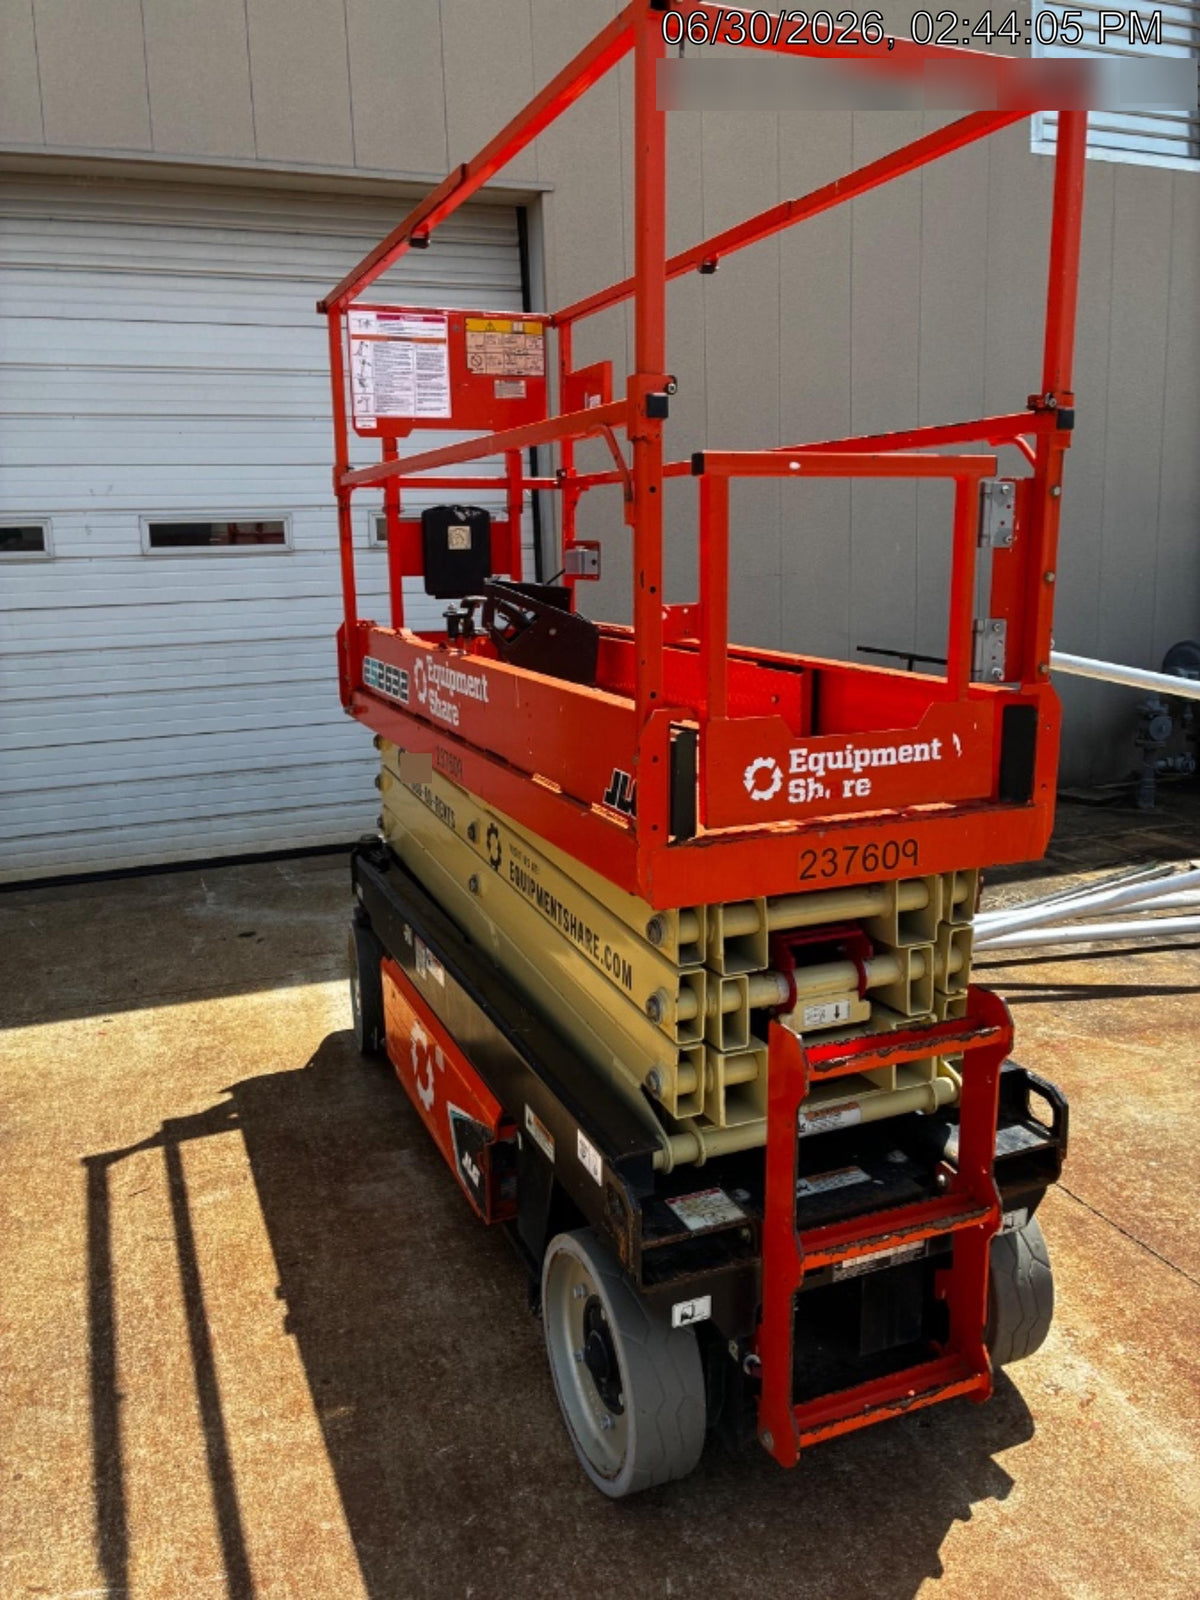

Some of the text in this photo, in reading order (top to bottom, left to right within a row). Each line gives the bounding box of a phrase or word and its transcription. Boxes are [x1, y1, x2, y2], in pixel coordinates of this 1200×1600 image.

[426, 655, 489, 703] Equipment
[428, 689, 460, 726] Share
[788, 737, 943, 777] Equipment
[788, 777, 872, 804] Shre
[799, 838, 920, 881] 237609
[509, 860, 633, 990] EQUIPMENTSHARE.COM
